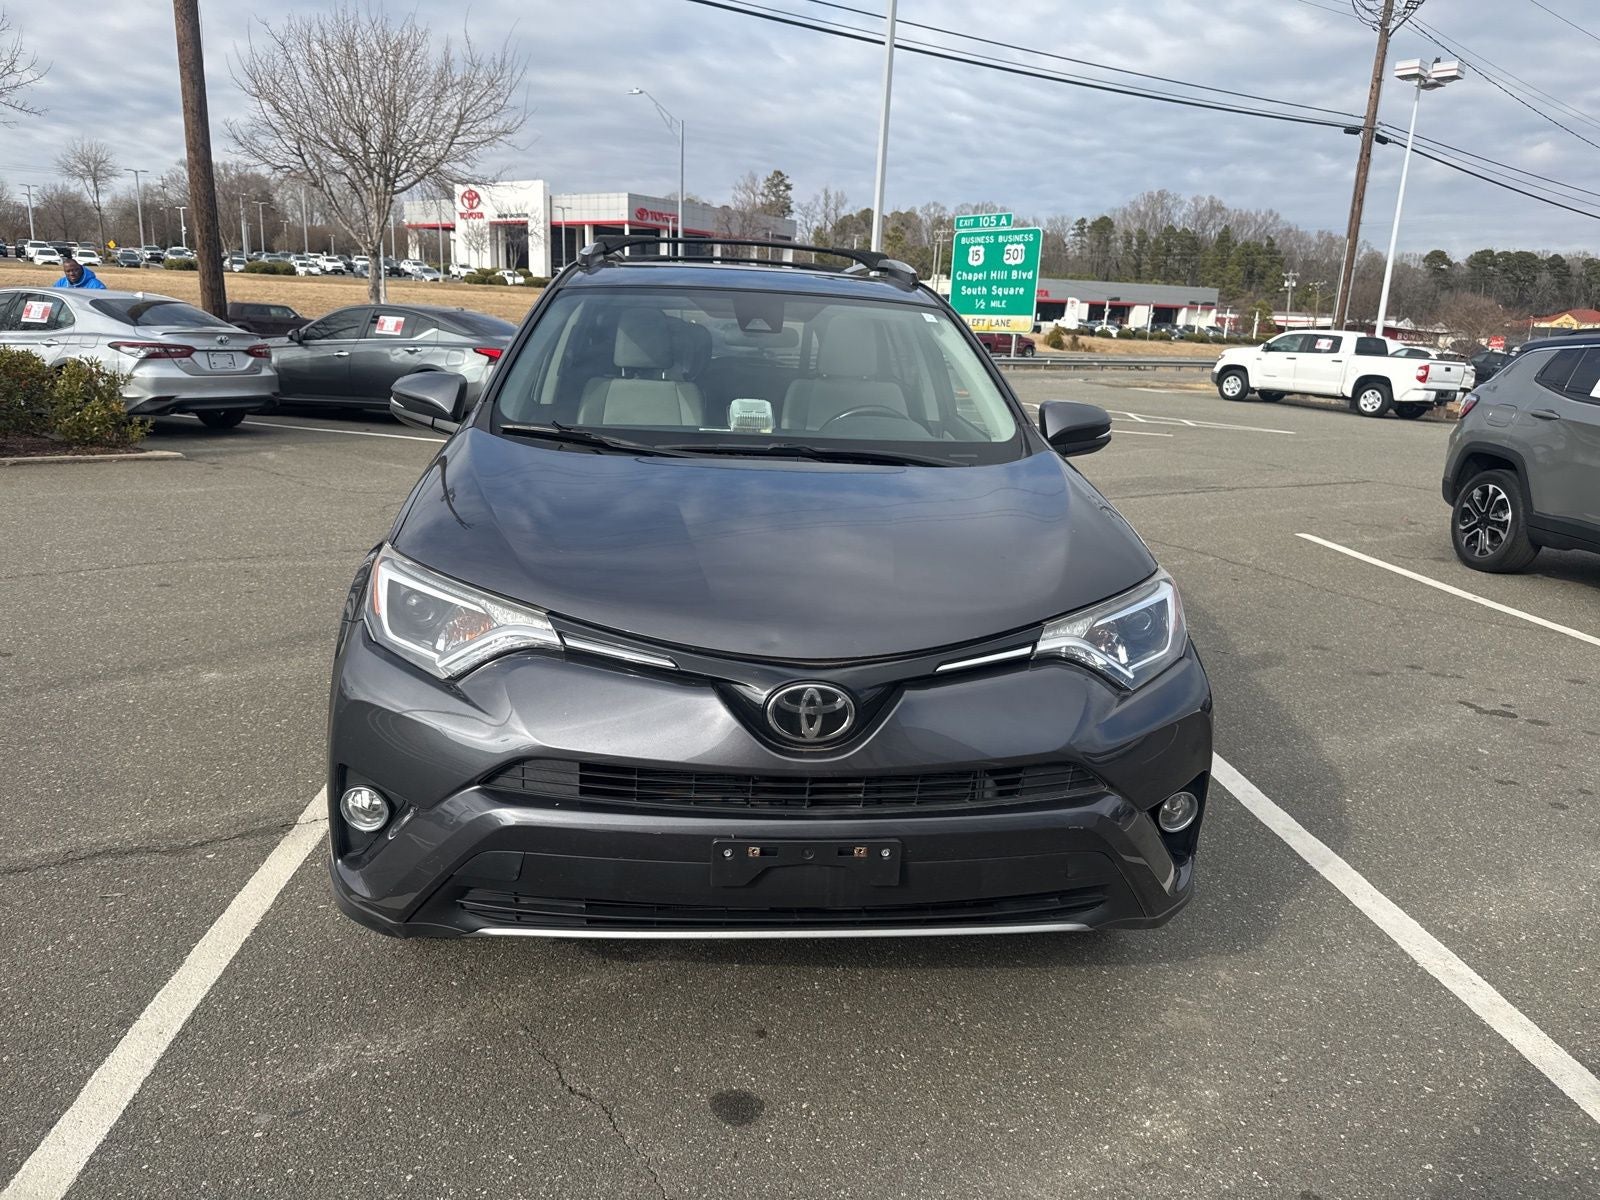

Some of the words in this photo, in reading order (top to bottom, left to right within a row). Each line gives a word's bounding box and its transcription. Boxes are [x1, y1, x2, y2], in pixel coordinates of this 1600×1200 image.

[959, 219, 974, 227] EXIT
[979, 217, 996, 227] 105
[1000, 216, 1007, 226] A
[961, 235, 995, 244] BUSINESS
[998, 233, 1034, 243] BUSINESS
[971, 250, 981, 262] 15
[1005, 248, 1024, 261] 501
[956, 271, 986, 282] Chapel
[990, 271, 1008, 280] Hill
[1011, 270, 1033, 280] Blvd
[961, 286, 987, 295] South
[991, 285, 1025, 296] Square
[990, 300, 1007, 308] MILE
[967, 318, 986, 327] LEFT
[990, 319, 1011, 327] LANE
